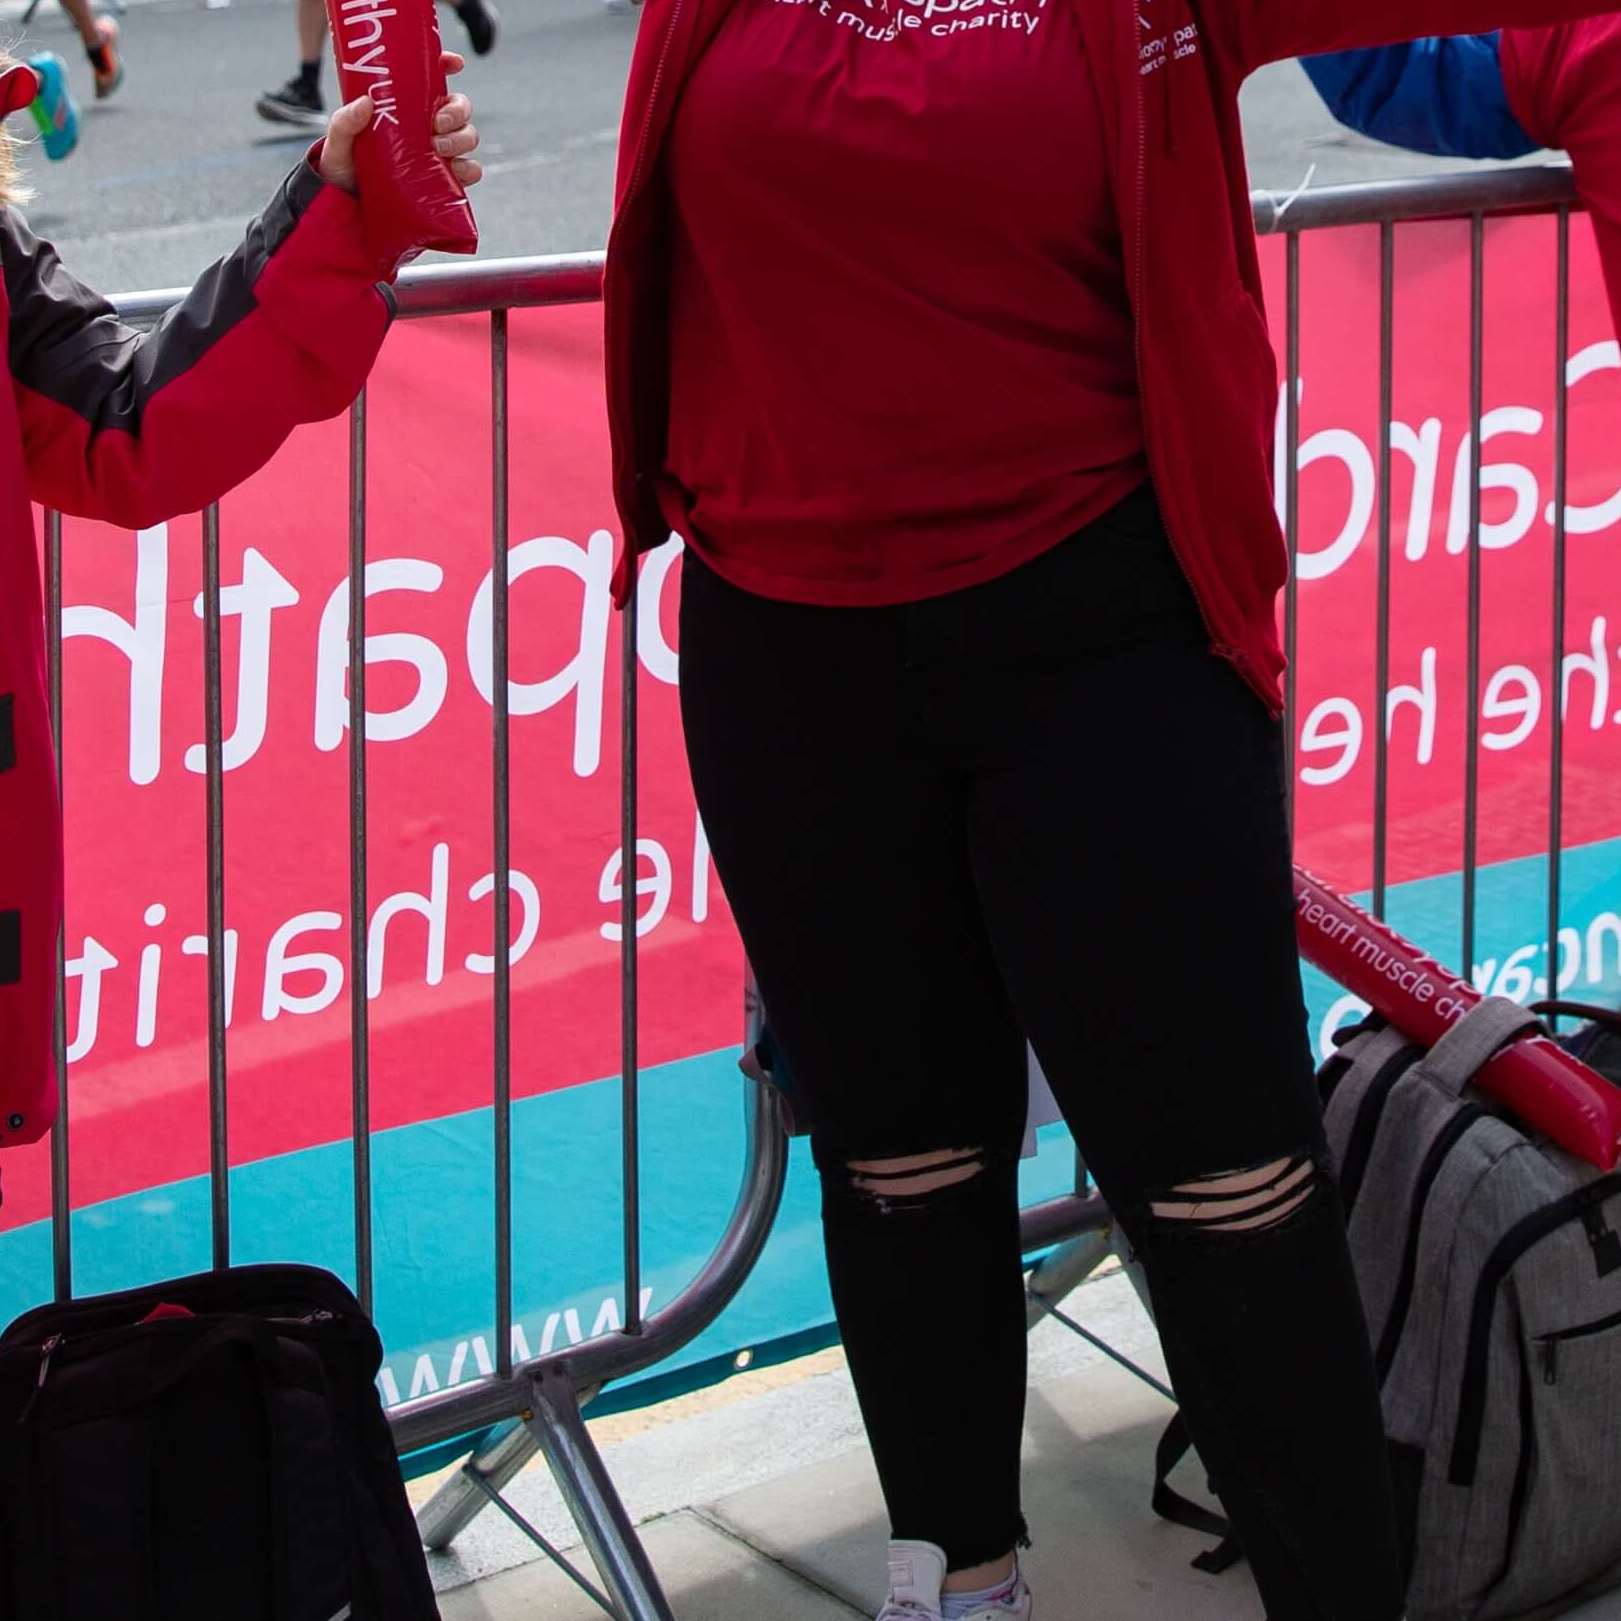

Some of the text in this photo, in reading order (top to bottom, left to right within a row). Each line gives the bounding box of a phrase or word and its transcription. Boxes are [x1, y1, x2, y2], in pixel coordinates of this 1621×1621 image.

[836, 8, 923, 42] musle
[930, 9, 1040, 36] charity
[366, 79, 400, 132] UK
[1297, 888, 1435, 1003] heart muscle
